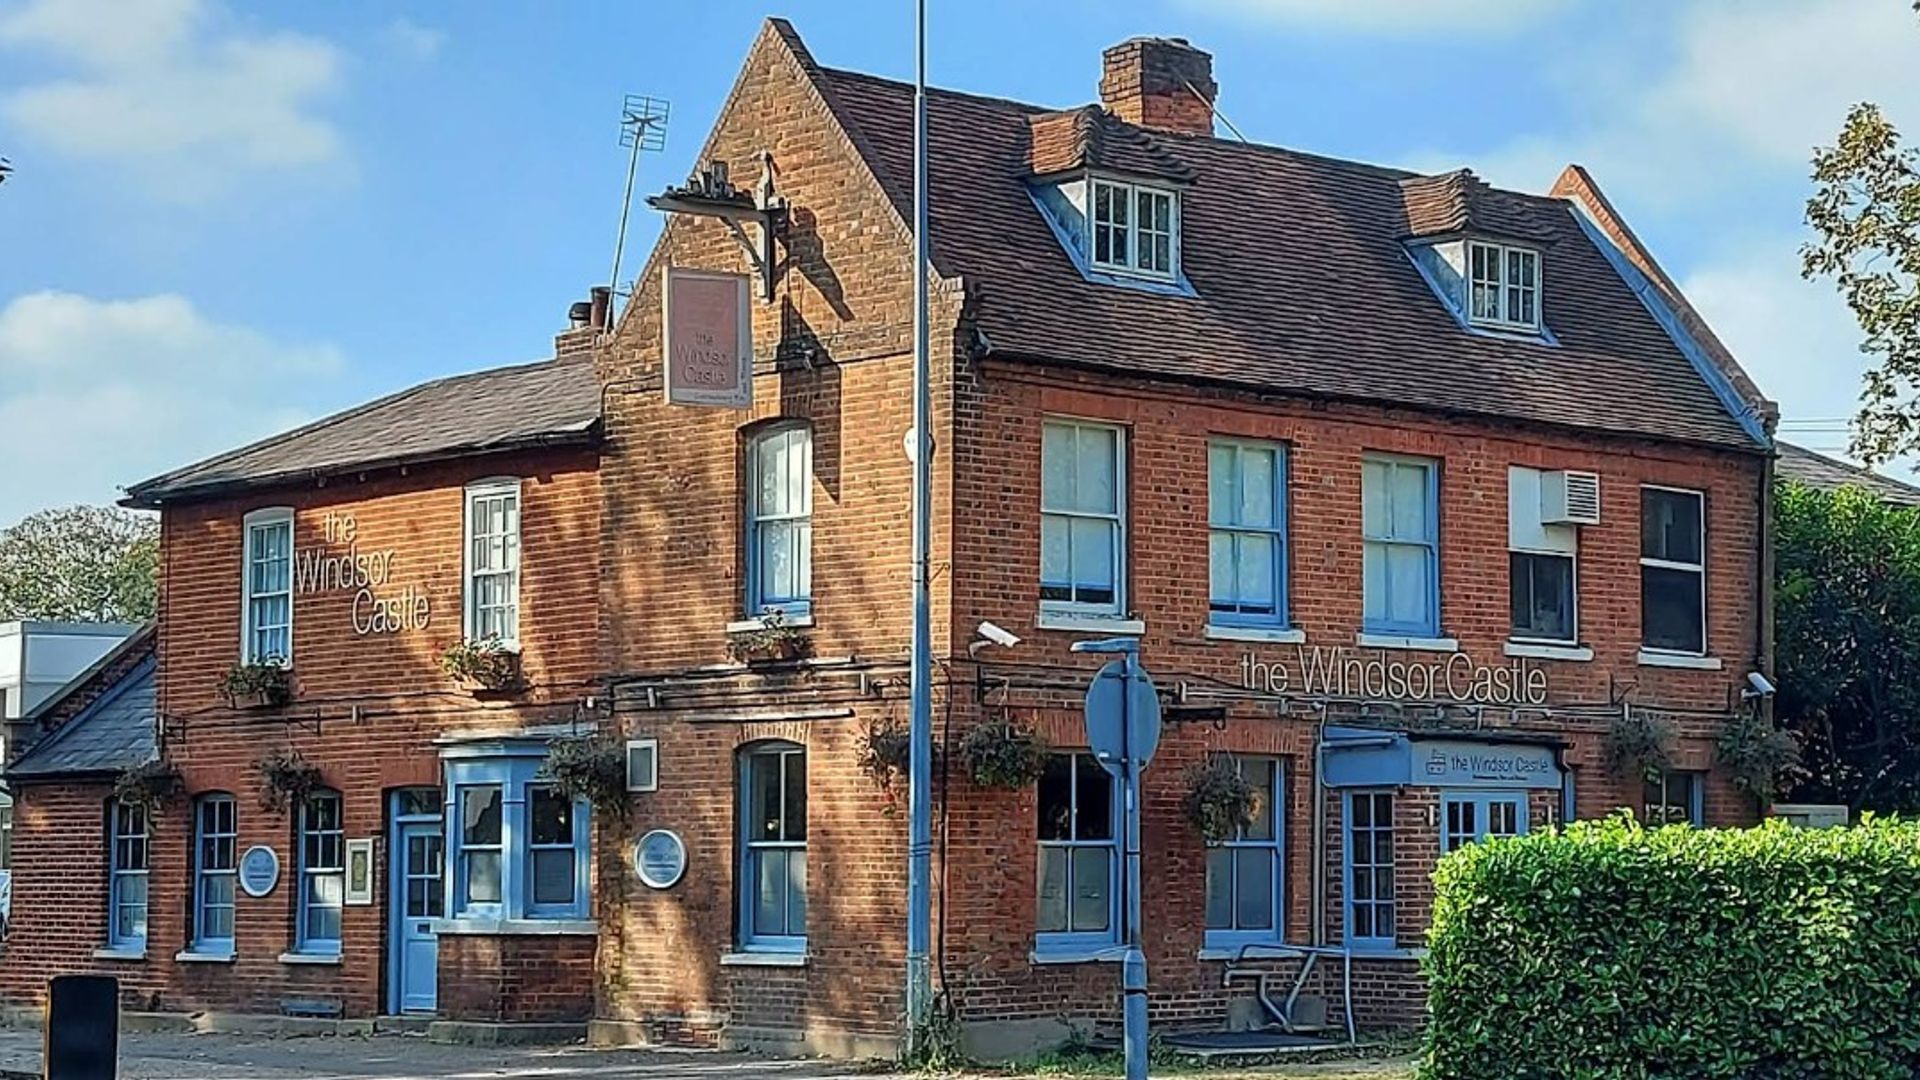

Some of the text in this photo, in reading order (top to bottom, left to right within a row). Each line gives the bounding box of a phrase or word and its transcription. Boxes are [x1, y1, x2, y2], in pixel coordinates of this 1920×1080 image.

[325, 513, 357, 543] the
[295, 543, 395, 595] Windsor
[352, 585, 430, 635] Castle
[1240, 645, 1548, 704] the Windsor Castle
[1451, 754, 1549, 774] the Windsor Castle
